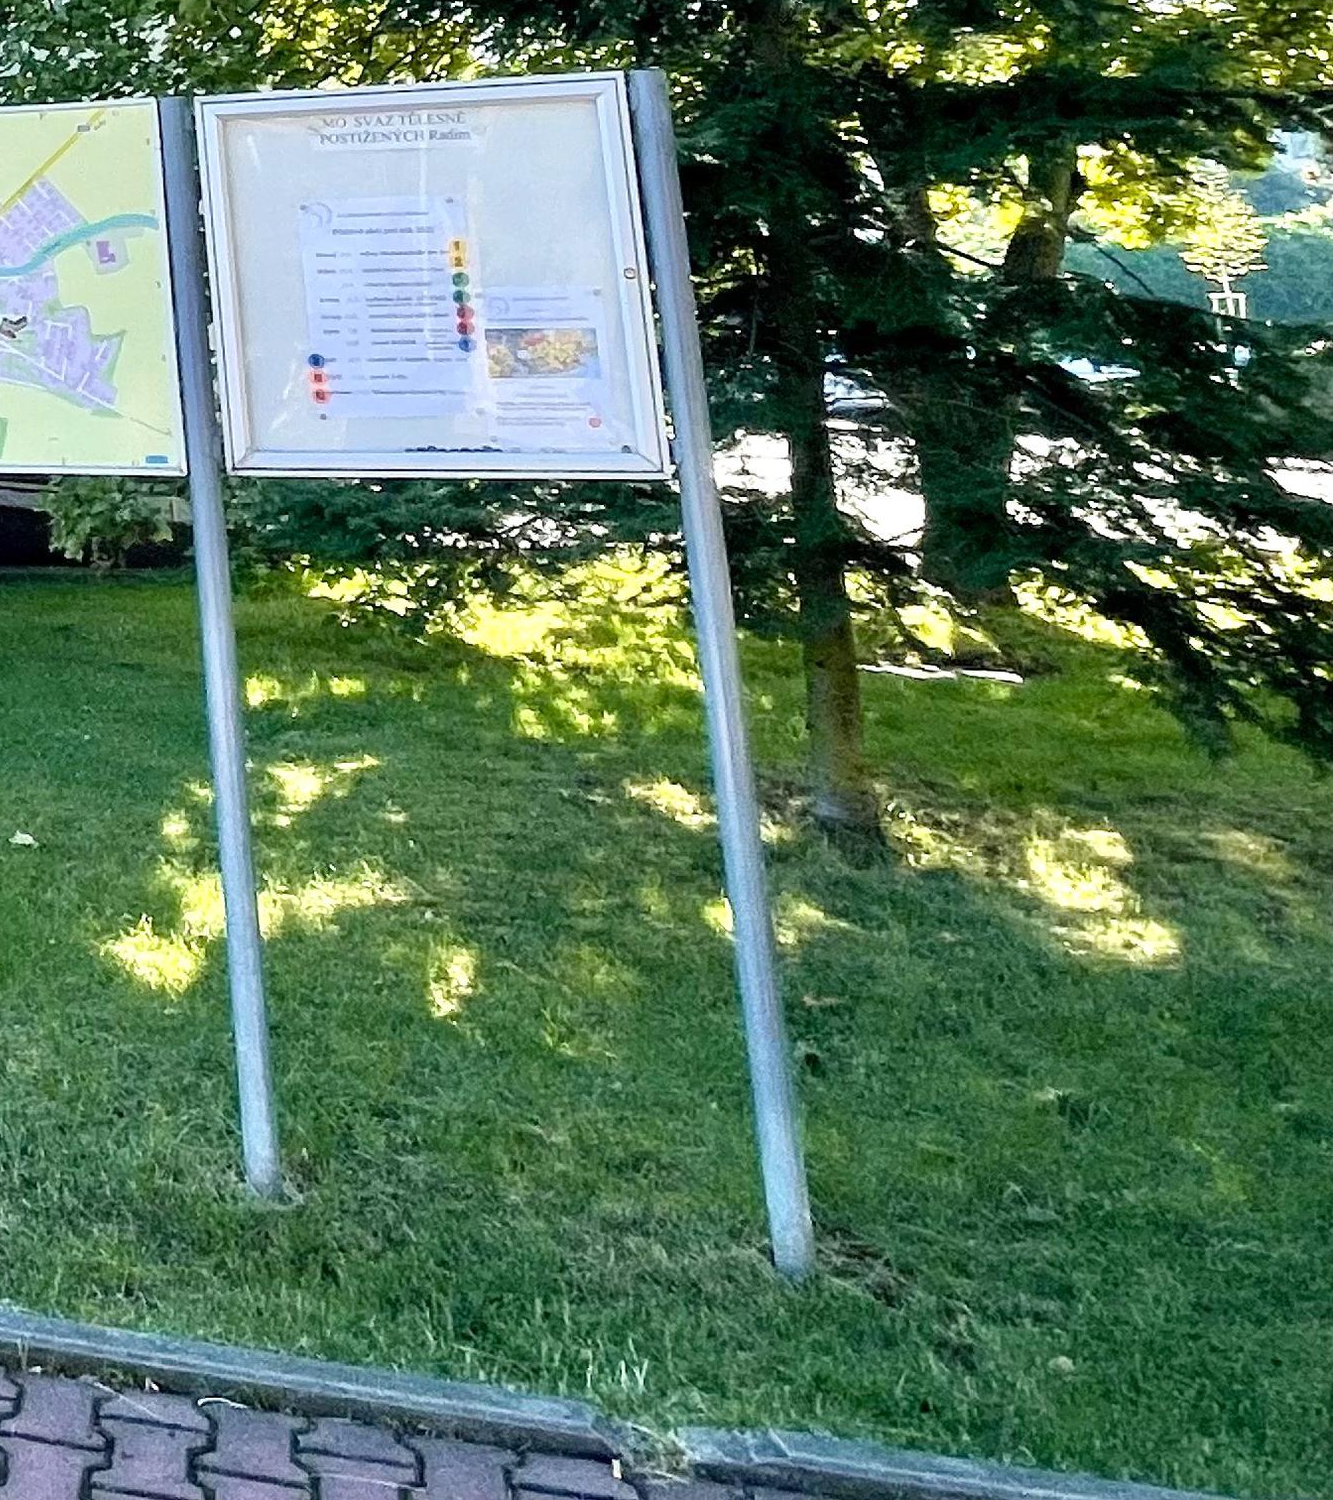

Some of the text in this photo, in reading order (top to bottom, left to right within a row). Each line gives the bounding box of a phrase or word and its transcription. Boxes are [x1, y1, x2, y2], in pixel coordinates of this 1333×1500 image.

[353, 114, 394, 128] SVAZ
[318, 128, 472, 145] POSTIŽENÝCH Radim
